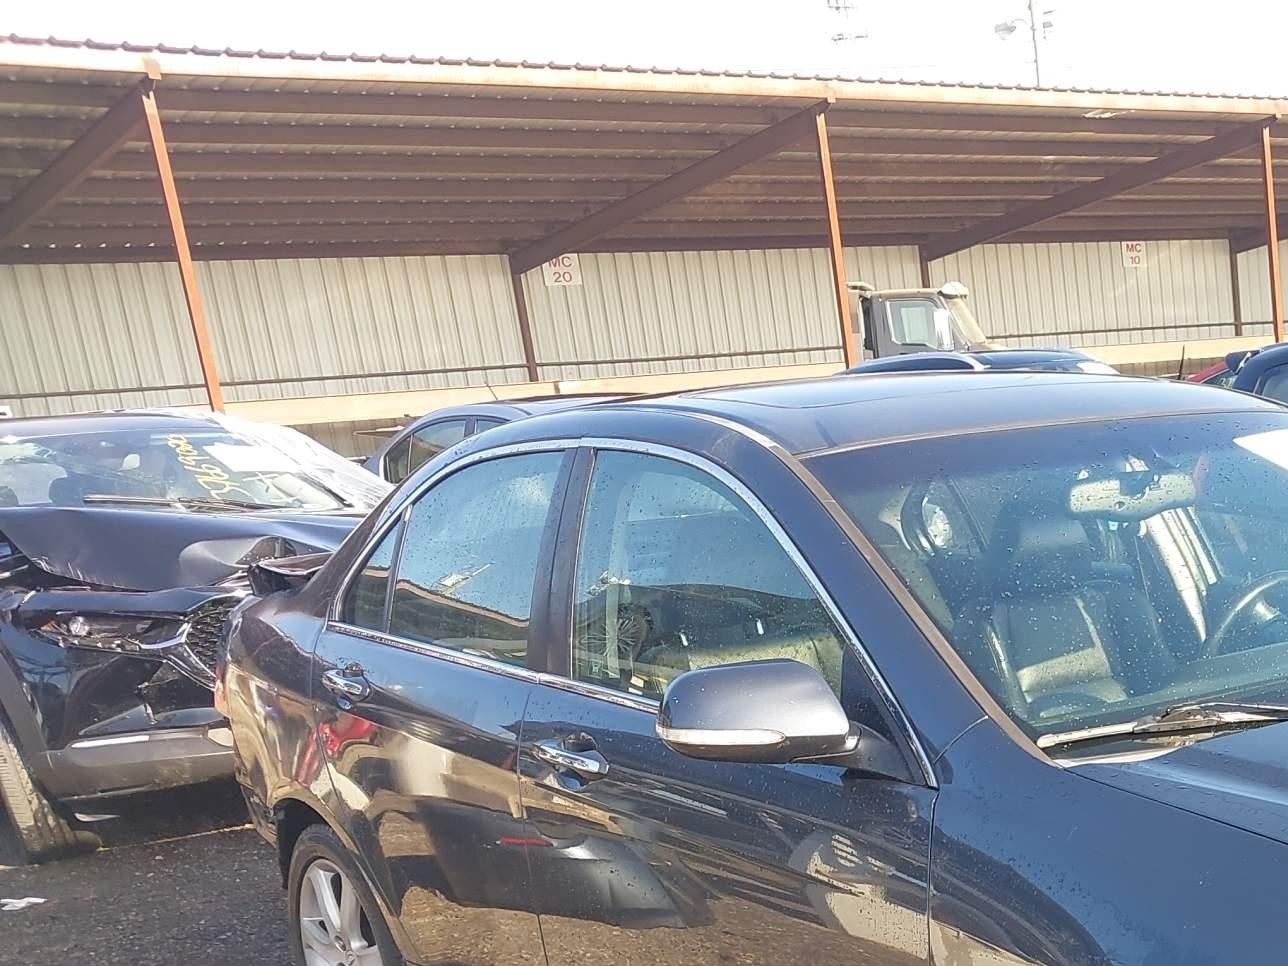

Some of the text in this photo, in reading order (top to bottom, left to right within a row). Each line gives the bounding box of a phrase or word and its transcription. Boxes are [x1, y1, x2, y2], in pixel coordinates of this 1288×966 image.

[1125, 243, 1142, 253] MC
[548, 256, 572, 268] MC
[1130, 256, 1141, 265] 10
[552, 271, 573, 283] 20
